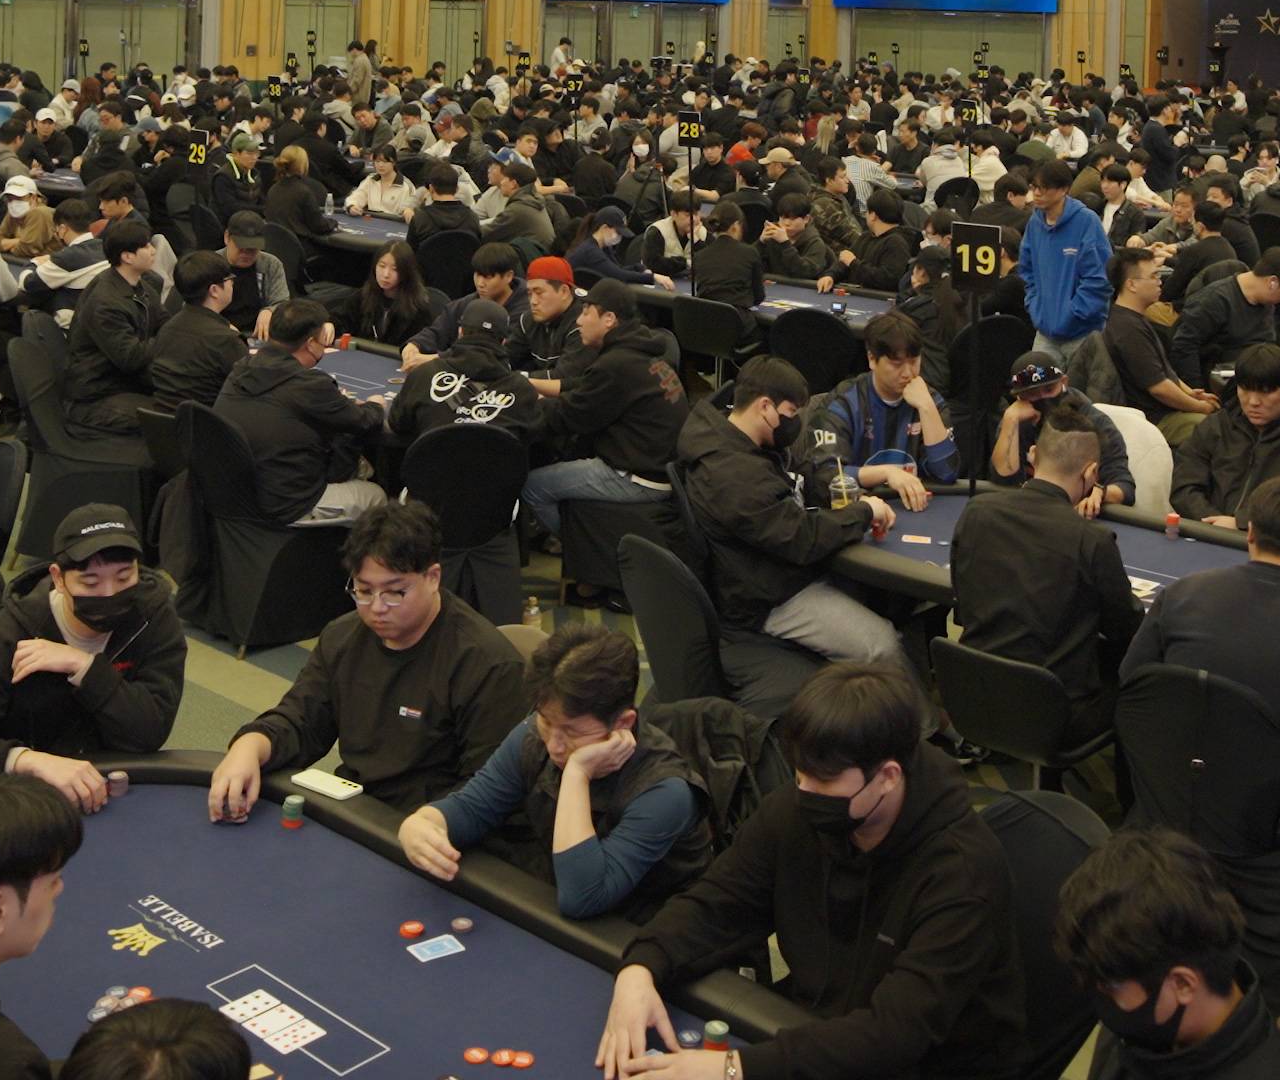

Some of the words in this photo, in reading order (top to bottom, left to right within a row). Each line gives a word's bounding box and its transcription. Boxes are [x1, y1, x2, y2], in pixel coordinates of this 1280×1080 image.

[977, 70, 988, 78] 35
[1120, 67, 1129, 75] 34
[1209, 64, 1219, 72] 33
[799, 74, 810, 83] 36
[269, 82, 281, 96] 38
[567, 80, 583, 91] 37
[963, 109, 976, 121] 27
[679, 122, 699, 138] 28
[188, 143, 206, 164] 29
[956, 243, 996, 275] 19
[137, 894, 225, 950] ISABELLE
